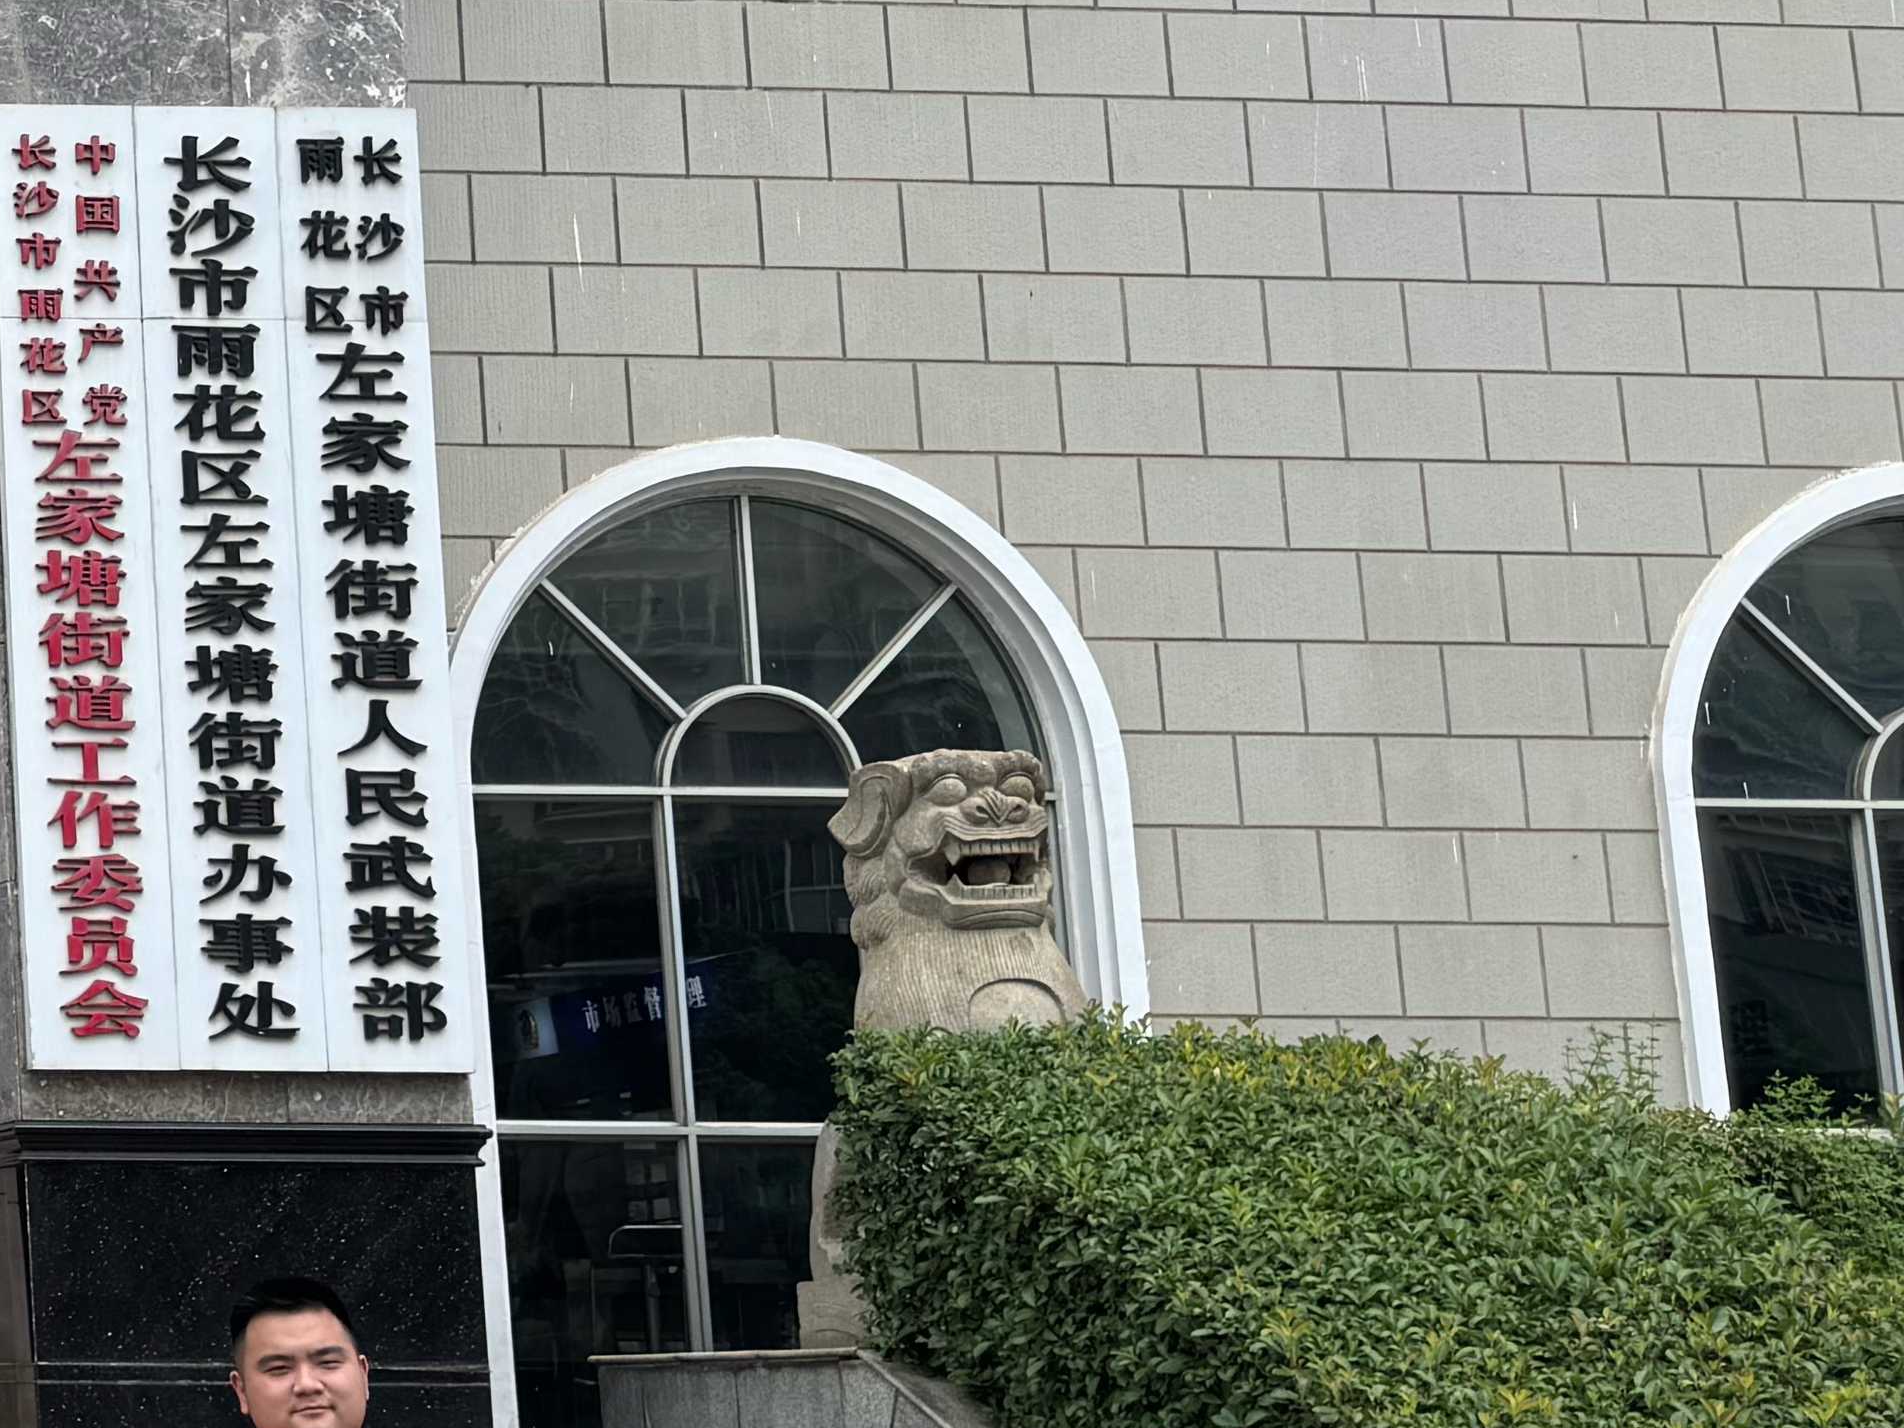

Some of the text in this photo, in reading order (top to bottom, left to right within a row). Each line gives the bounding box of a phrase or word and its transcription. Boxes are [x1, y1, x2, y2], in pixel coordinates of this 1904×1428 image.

[12, 134, 68, 425] 长沙市雨花区
[74, 137, 130, 427] 中国共产党
[296, 136, 353, 334] 雨花区
[353, 136, 409, 336] 长沙市
[164, 136, 300, 1041] 长沙市雨花区左家塘街道办事处
[316, 343, 447, 1042] 左家塘街道人民武装部
[34, 429, 149, 1040] 左家塘街道工作委员会
